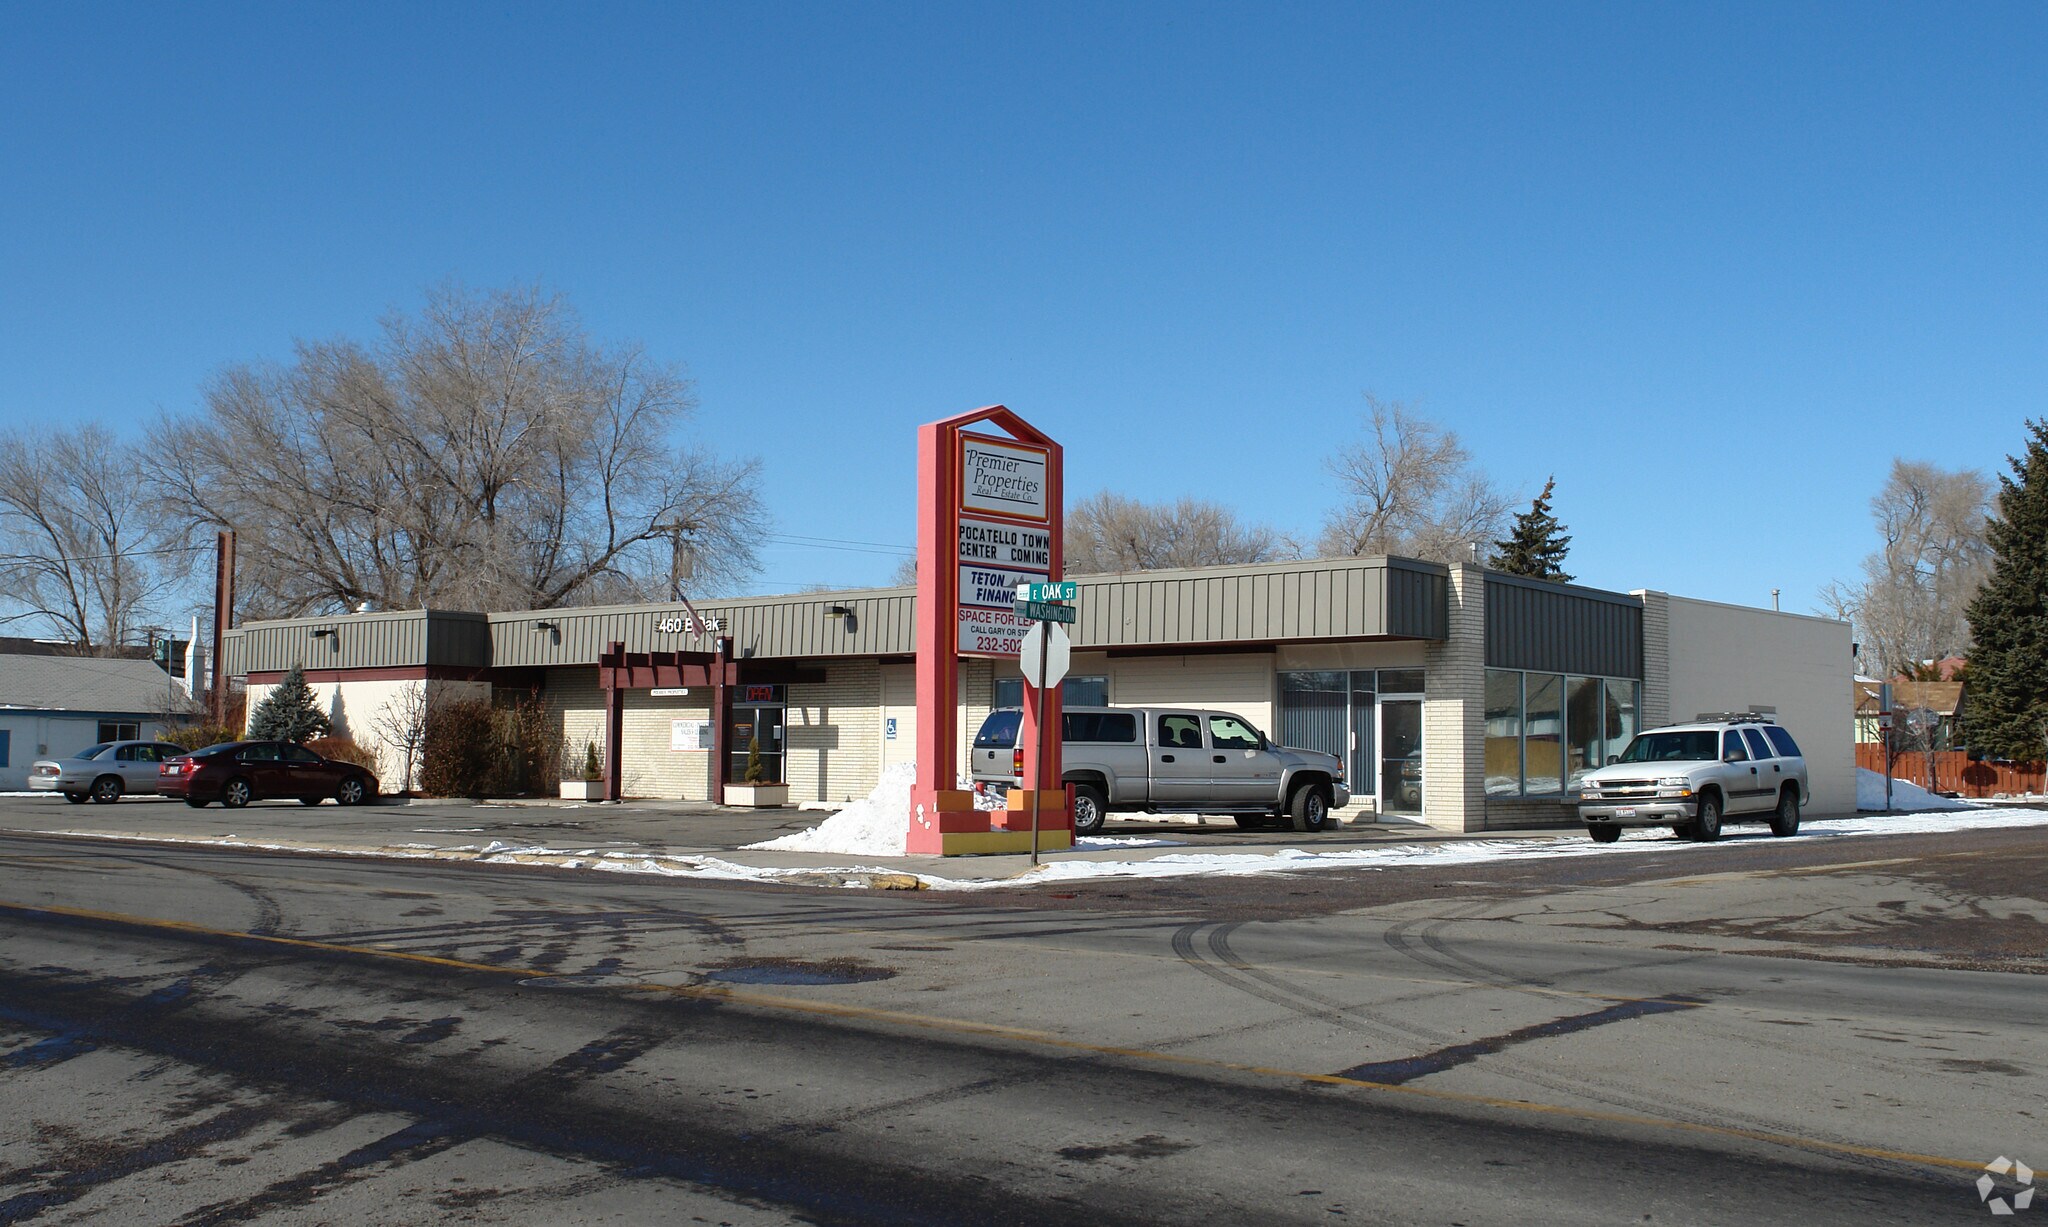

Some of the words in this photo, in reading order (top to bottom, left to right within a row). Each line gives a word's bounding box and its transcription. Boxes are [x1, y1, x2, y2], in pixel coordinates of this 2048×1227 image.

[967, 449, 1020, 473] Premier
[973, 467, 1039, 493] Properties
[976, 485, 992, 495] Real
[1000, 489, 1021, 500] Estate
[959, 525, 1017, 546] POCATELLO
[1022, 533, 1049, 549] TOWN
[960, 542, 997, 559] CENTER
[1010, 548, 1048, 565] COMING
[971, 571, 1006, 587] TETON
[976, 587, 1016, 604] FINANC
[1033, 589, 1037, 600] E
[1041, 584, 1062, 599] OAK
[1065, 588, 1074, 598] ST
[959, 609, 992, 624] SPACE
[994, 613, 1015, 625] FOR
[1017, 616, 1037, 627] LEA
[1029, 603, 1076, 623] WASHINGTON
[659, 617, 682, 633] 460
[970, 625, 986, 634] CALL
[988, 626, 1006, 636] GARY
[1007, 628, 1016, 636] OR
[1017, 629, 1030, 637] STE
[976, 636, 1022, 653] 232-502
[747, 687, 772, 701] OPEN
